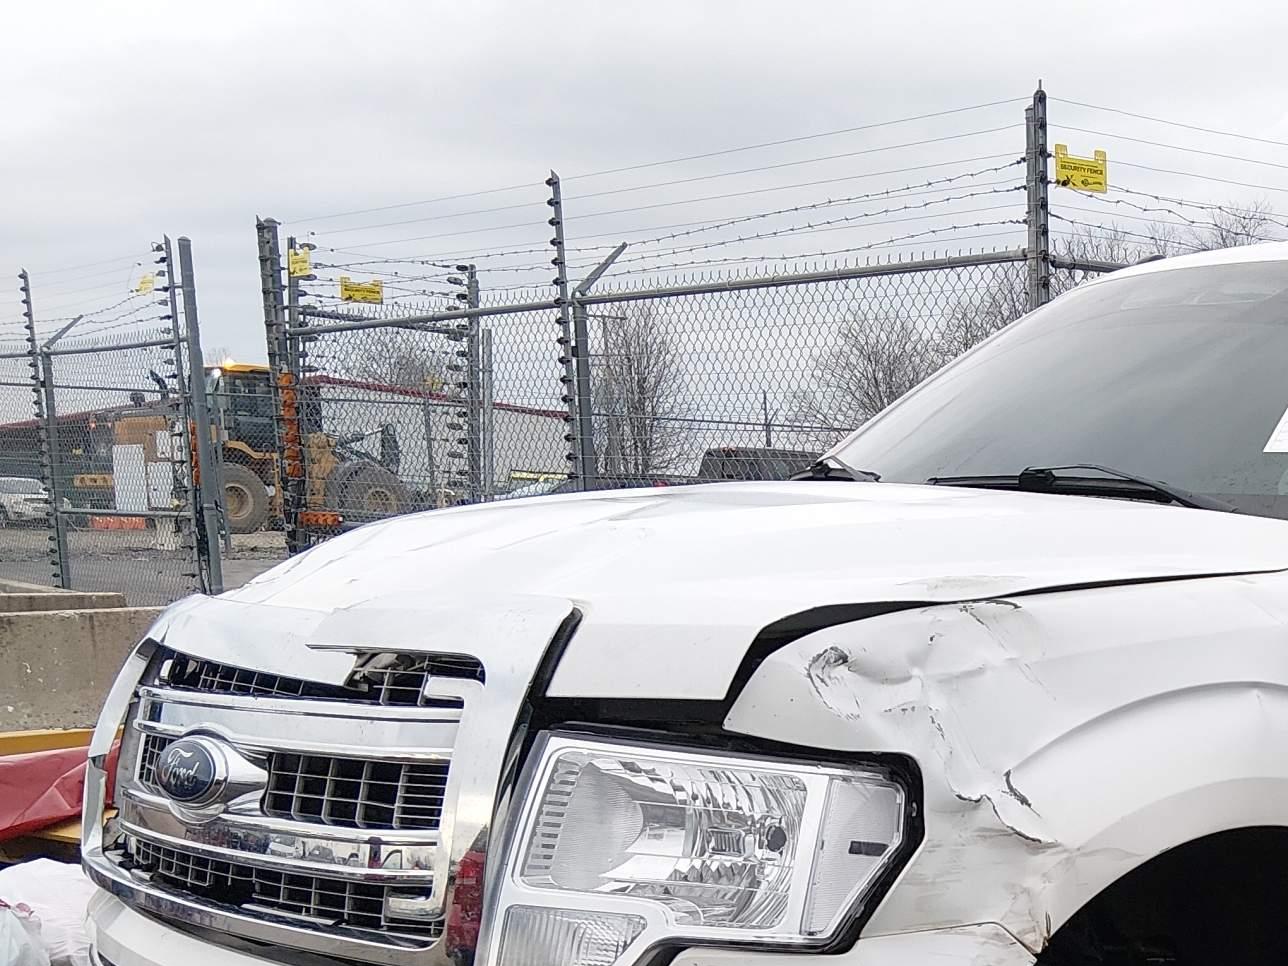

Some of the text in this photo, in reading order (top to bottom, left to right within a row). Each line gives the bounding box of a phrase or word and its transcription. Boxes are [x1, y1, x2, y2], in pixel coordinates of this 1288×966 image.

[1060, 163, 1086, 173] SECURITY
[1086, 167, 1103, 176] FENCE
[161, 747, 200, 785] Ford
